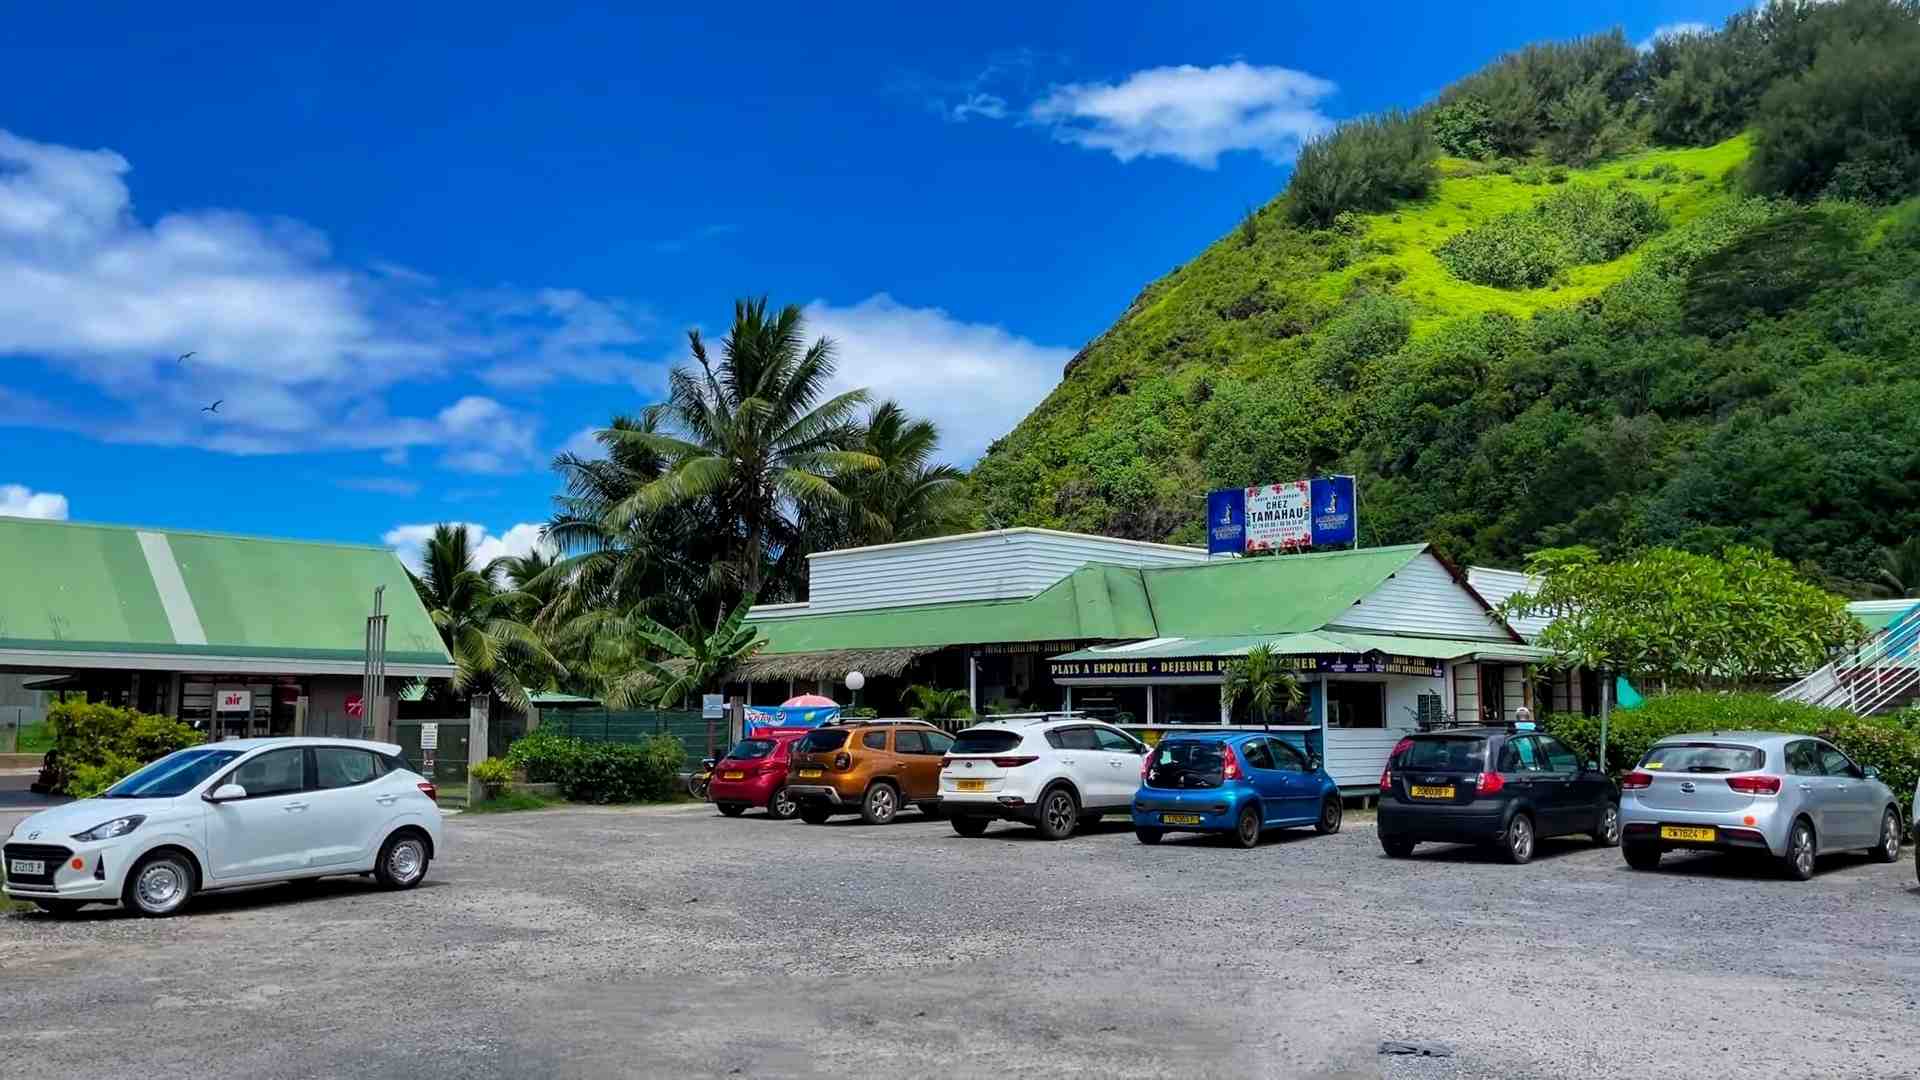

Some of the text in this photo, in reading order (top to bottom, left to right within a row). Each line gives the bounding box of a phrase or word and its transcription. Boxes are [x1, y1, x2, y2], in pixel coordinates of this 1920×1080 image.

[1265, 499, 1288, 510] CHEZ
[1251, 507, 1303, 522] TAMAHAU
[1083, 663, 1091, 674] A
[1093, 662, 1148, 674] EMPORTER
[1160, 660, 1214, 674] DEJEUNER
[224, 693, 243, 705] air
